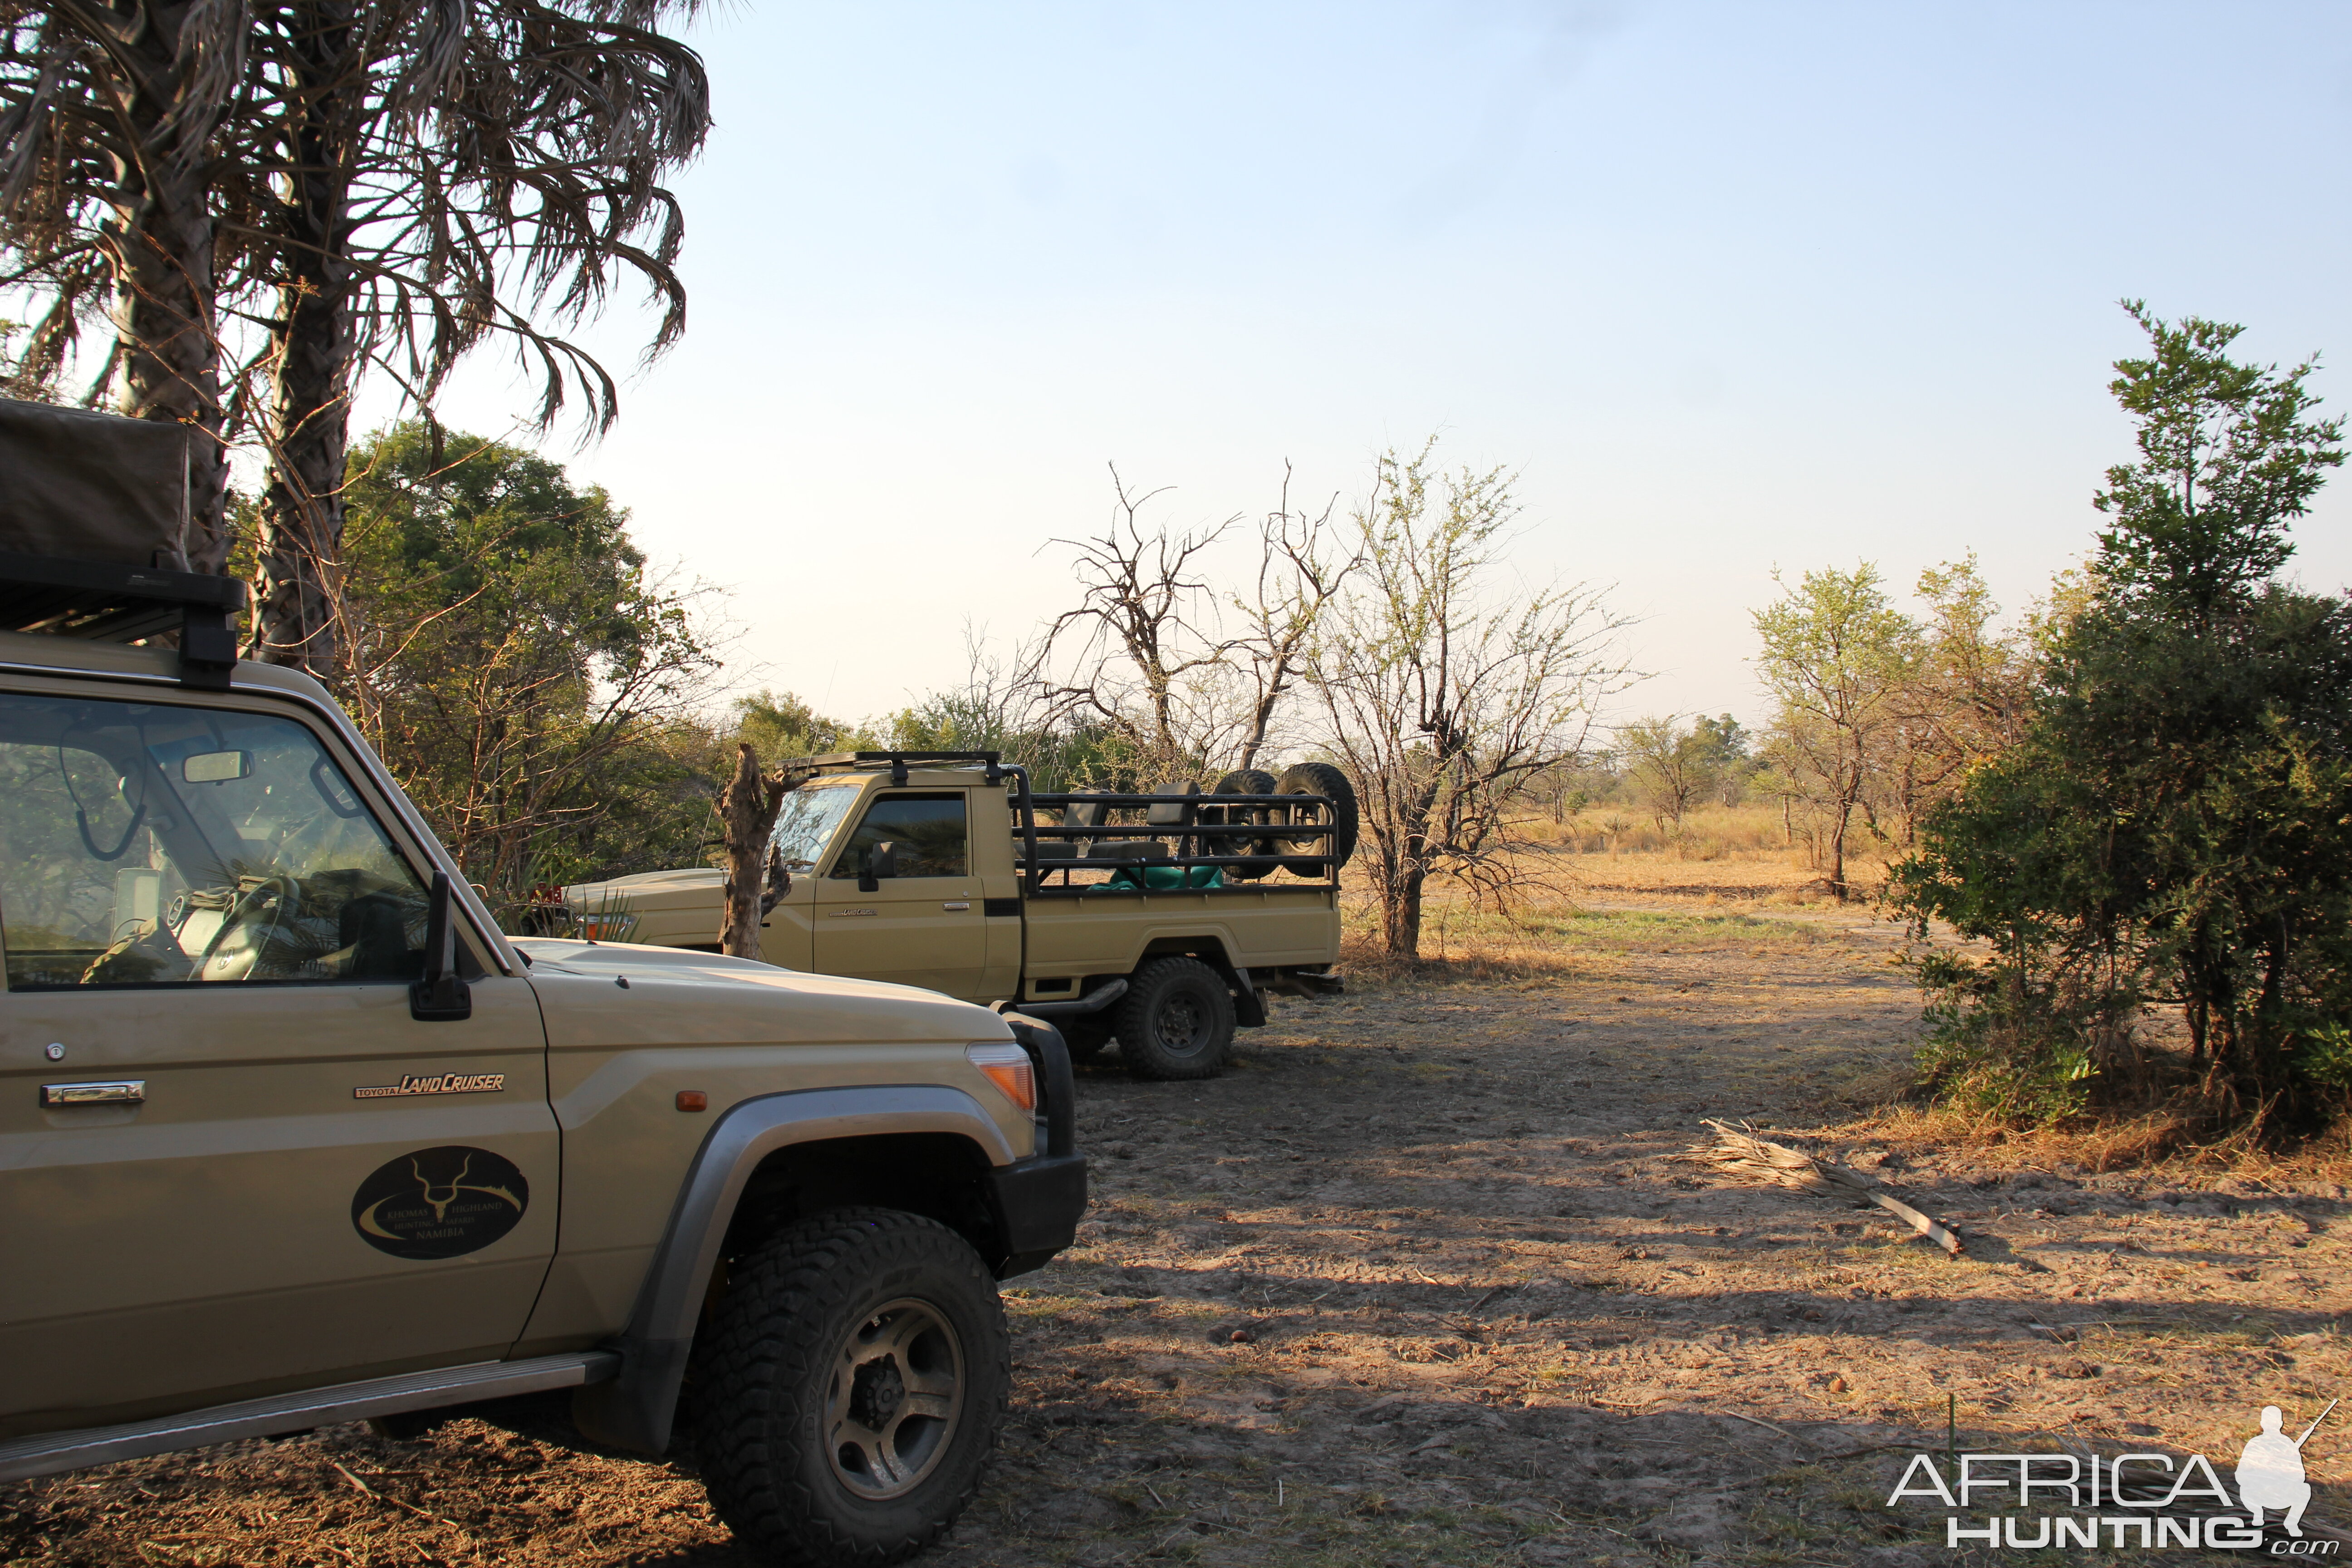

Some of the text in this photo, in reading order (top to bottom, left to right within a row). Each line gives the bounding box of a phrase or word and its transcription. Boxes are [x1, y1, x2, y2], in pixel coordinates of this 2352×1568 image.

[359, 1088, 396, 1096] TOYOTA
[387, 1202, 502, 1219] KHOMAS HIGHLAND
[394, 1216, 475, 1230] HUNTING SAFARIS
[416, 1227, 465, 1240] NAMIBIA
